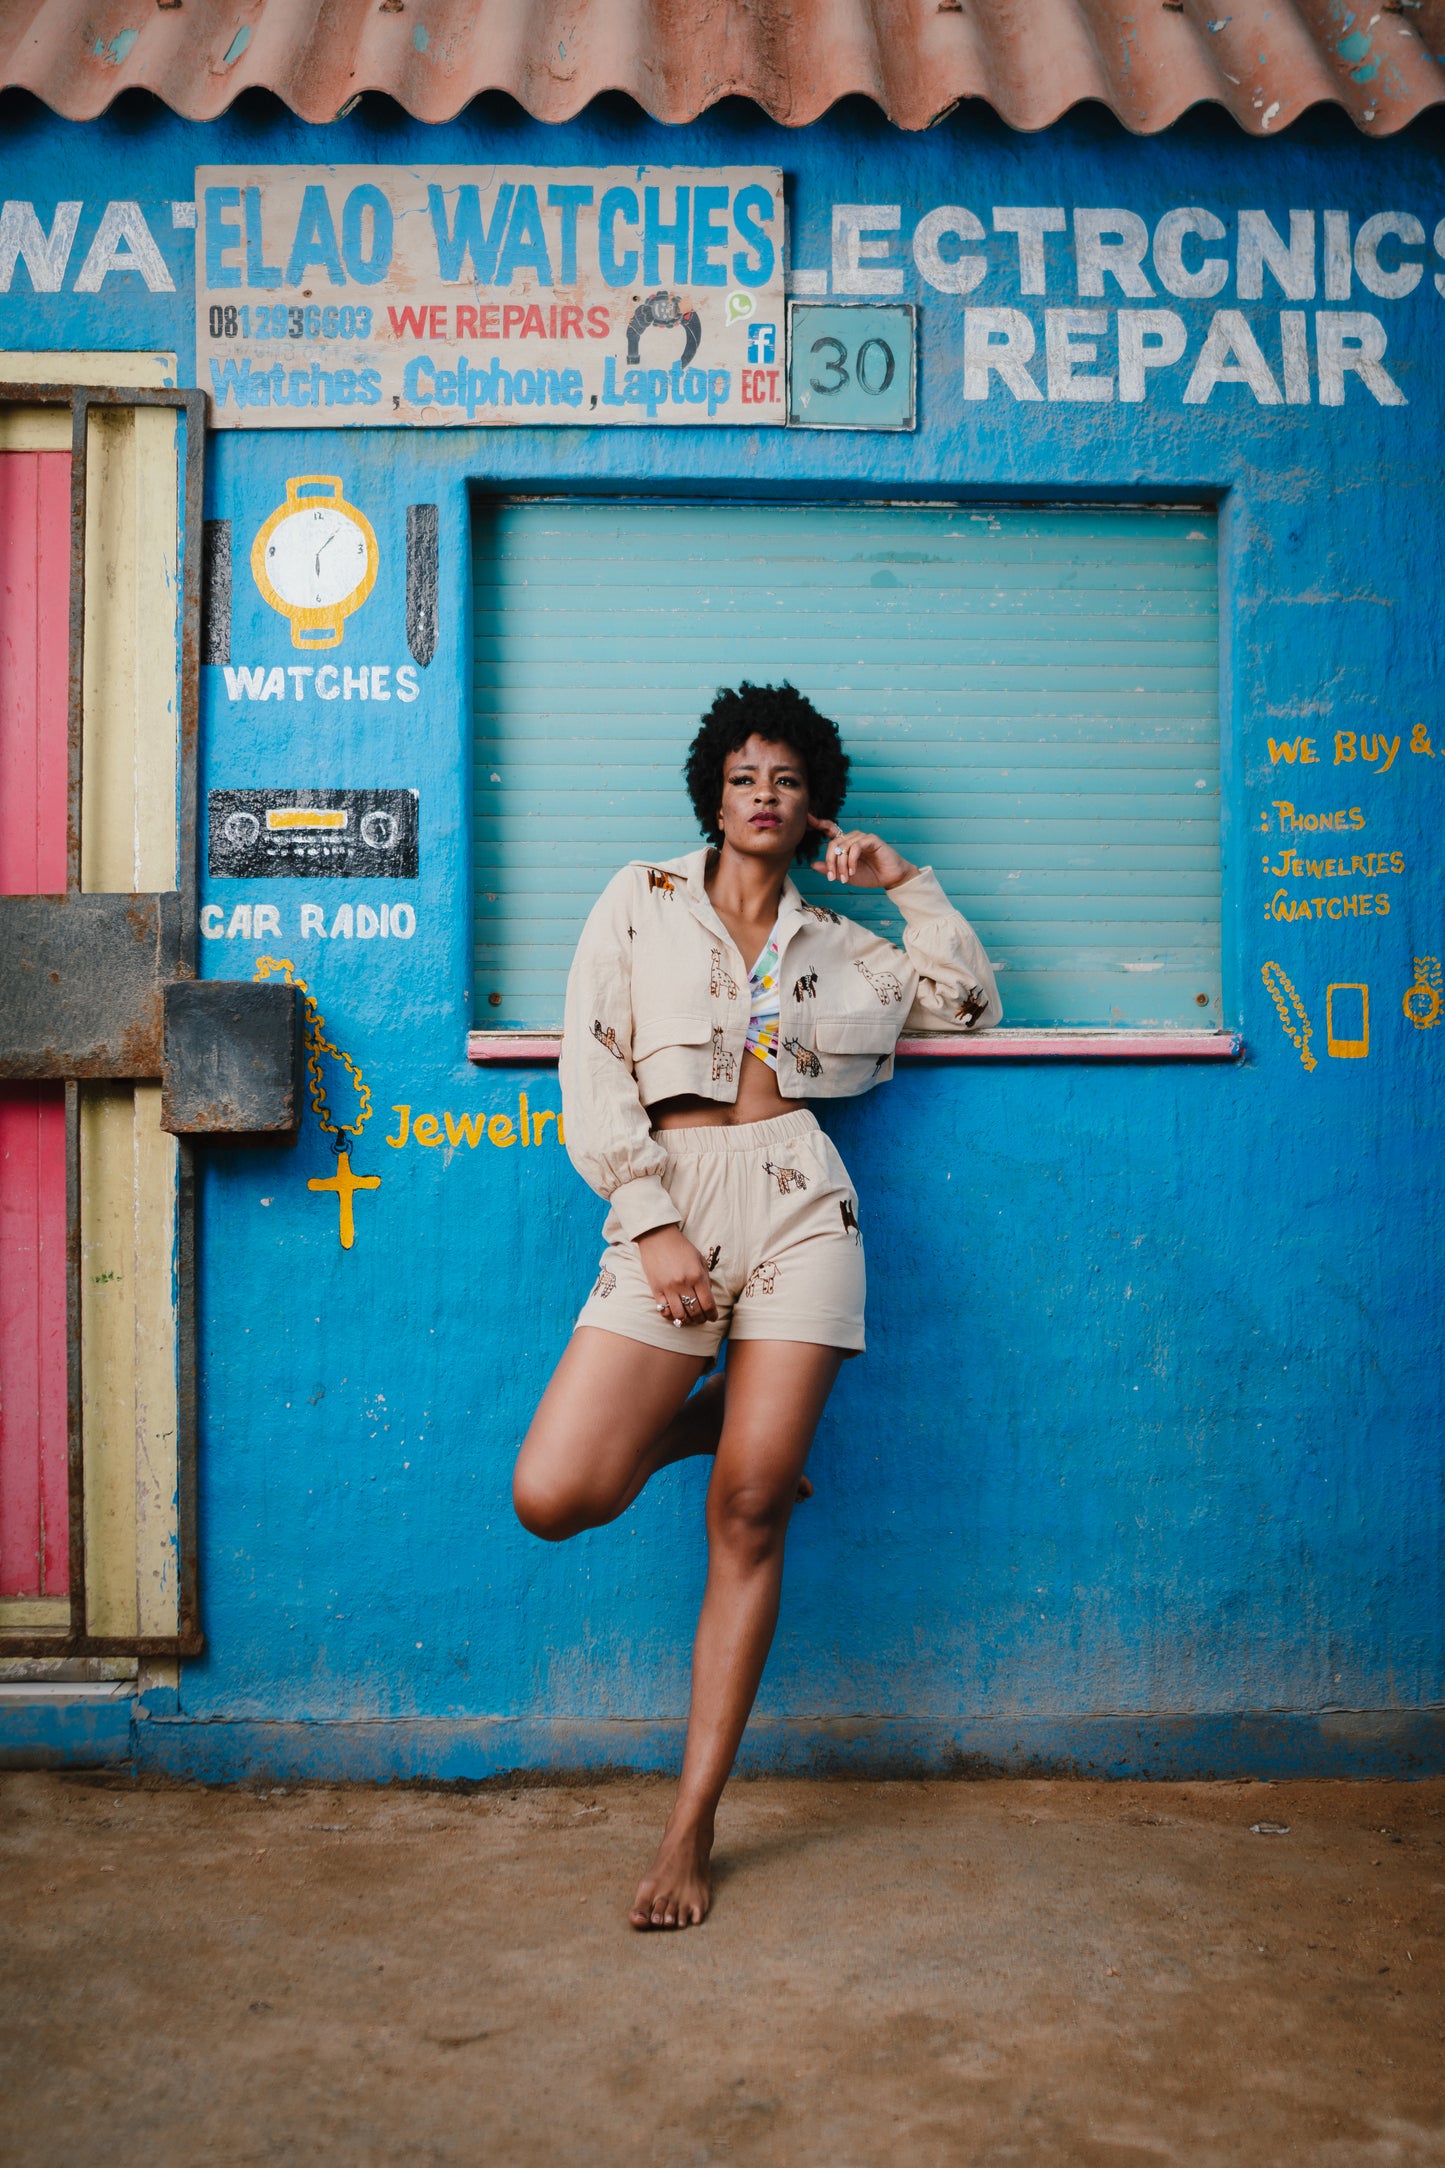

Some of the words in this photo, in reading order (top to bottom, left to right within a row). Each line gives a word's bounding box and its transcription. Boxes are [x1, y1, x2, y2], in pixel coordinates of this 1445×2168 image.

[0, 201, 196, 292] WA
[205, 184, 393, 289] ELAO
[427, 184, 775, 287] WATCHES
[387, 305, 448, 340] WE
[456, 304, 610, 340] REPAIRS
[810, 336, 895, 395] 30
[964, 308, 1408, 406] REPAIR
[741, 369, 781, 404] ECT.
[223, 665, 420, 702] WATCHES
[1267, 736, 1320, 765] WE
[200, 904, 283, 939] CAR
[301, 903, 416, 939] RADIO
